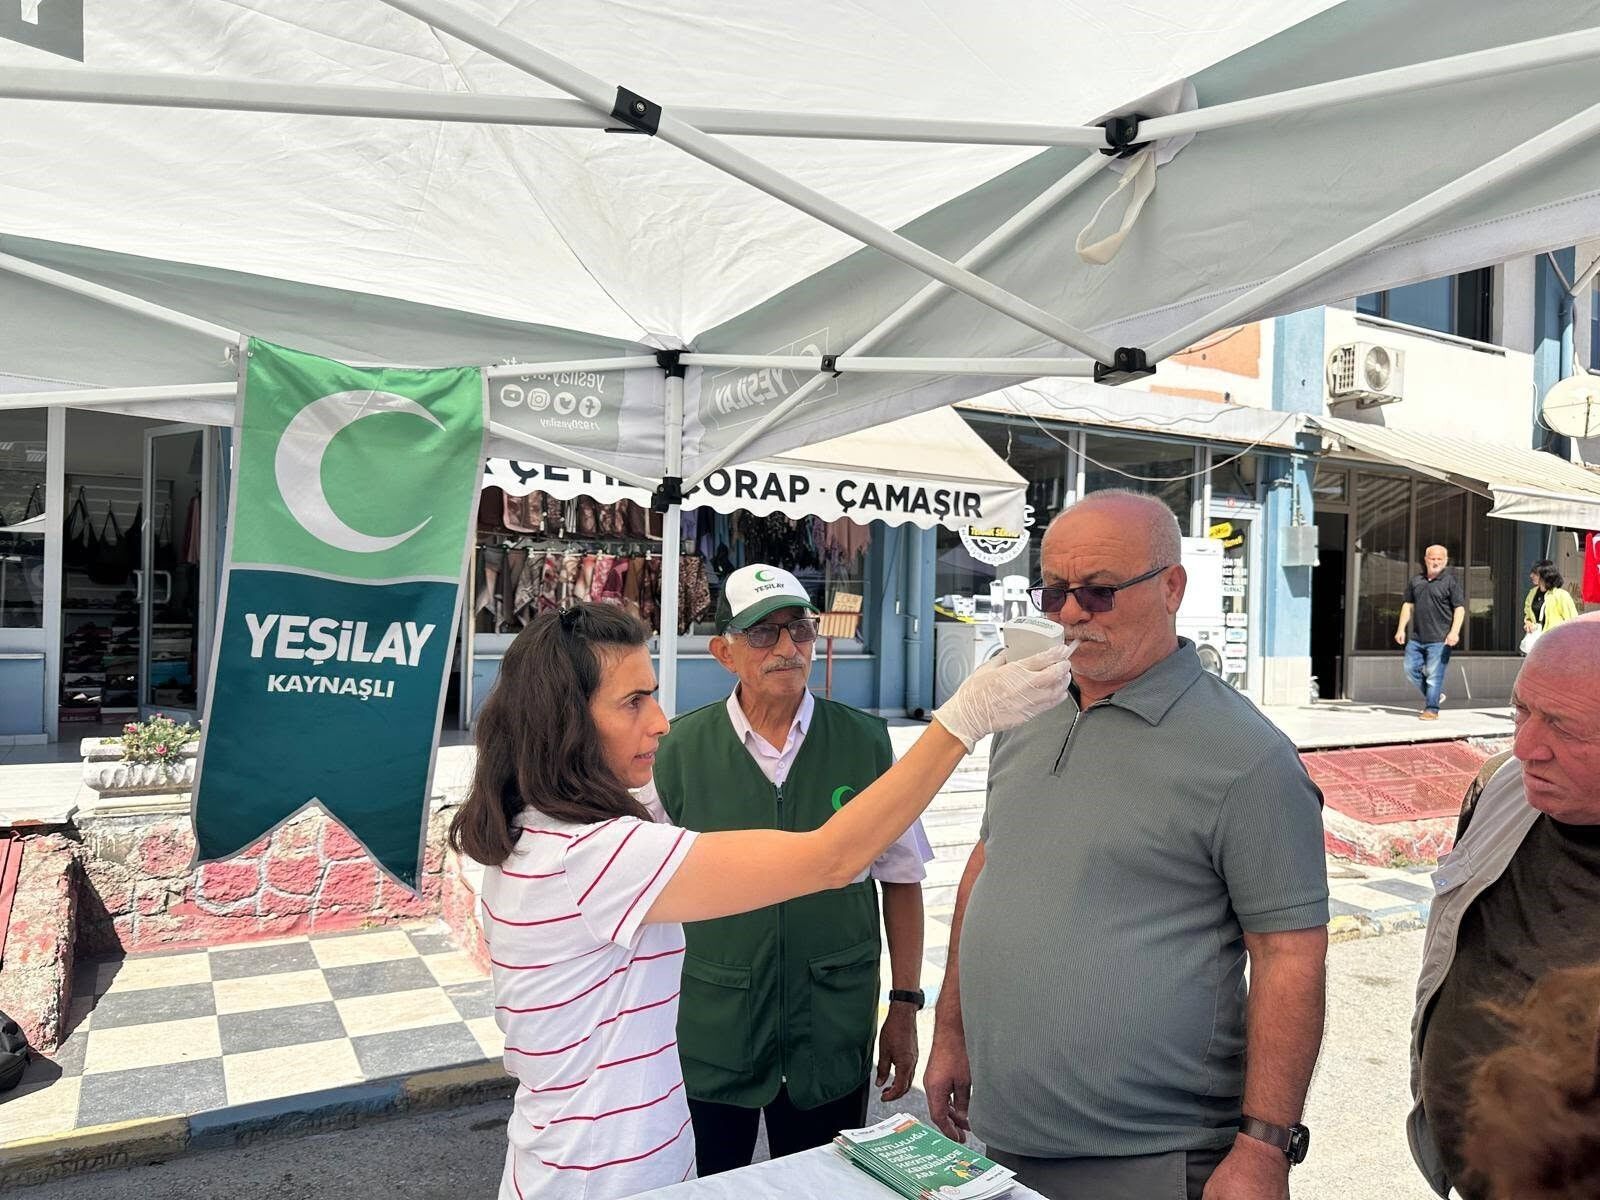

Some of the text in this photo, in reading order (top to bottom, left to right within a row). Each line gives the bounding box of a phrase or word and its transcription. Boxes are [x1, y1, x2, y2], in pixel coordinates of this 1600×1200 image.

[684, 469, 810, 503] ORAP
[836, 480, 983, 521] ÇAMAŞIR
[267, 674, 395, 701] KAYNAŞLI
